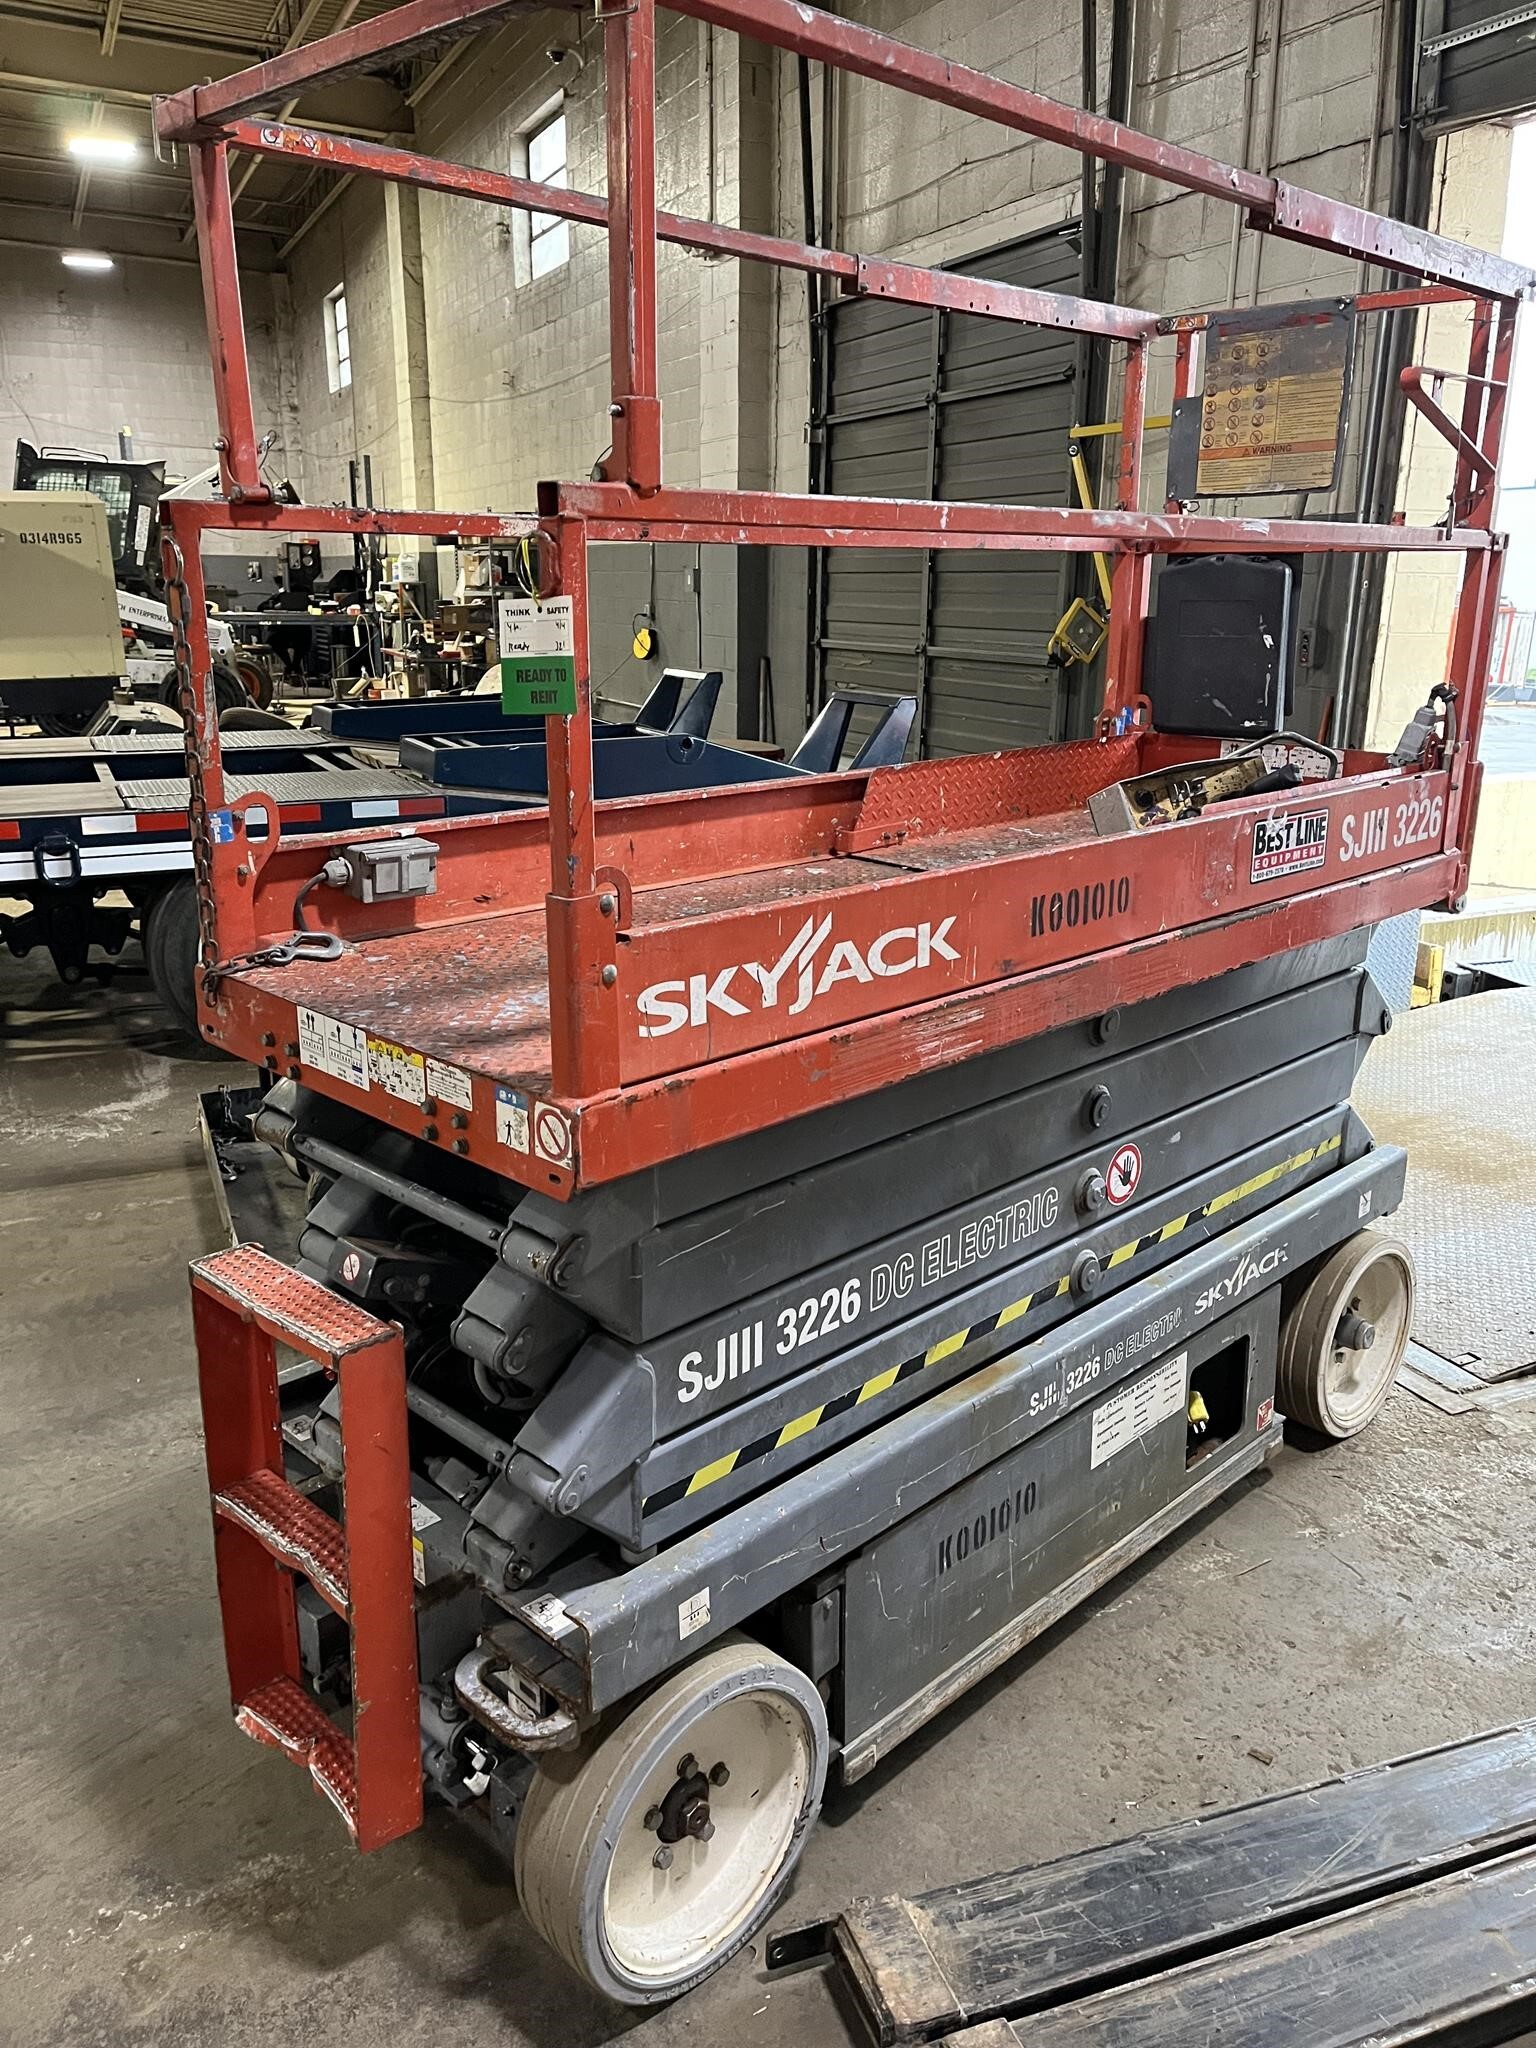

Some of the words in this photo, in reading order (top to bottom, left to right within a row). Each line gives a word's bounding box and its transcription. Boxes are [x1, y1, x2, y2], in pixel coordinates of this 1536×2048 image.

[1252, 444, 1292, 455] WARNING
[19, 532, 82, 544] 0314R965
[128, 606, 167, 622] ENTERPRISES
[505, 608, 531, 617] THINK
[546, 606, 569, 615] SAFETY
[516, 669, 553, 683] READY
[555, 668, 567, 682] TO
[530, 690, 558, 704] RENT
[1339, 807, 1390, 862] SJIII
[1393, 795, 1443, 848] 3226
[1254, 844, 1324, 870] EQUIPMENT
[1030, 876, 1130, 938] K001010
[636, 911, 962, 1039] SKYJACK
[677, 1320, 764, 1403] SJIII
[776, 1278, 861, 1356] 3226
[869, 1252, 915, 1313] DC
[921, 1186, 1059, 1288] ELECTRIC
[1066, 1356, 1101, 1395] 3226
[1104, 1341, 1125, 1372] DC
[1125, 1307, 1184, 1359] ELECTRI
[939, 1481, 1036, 1577] K001010
